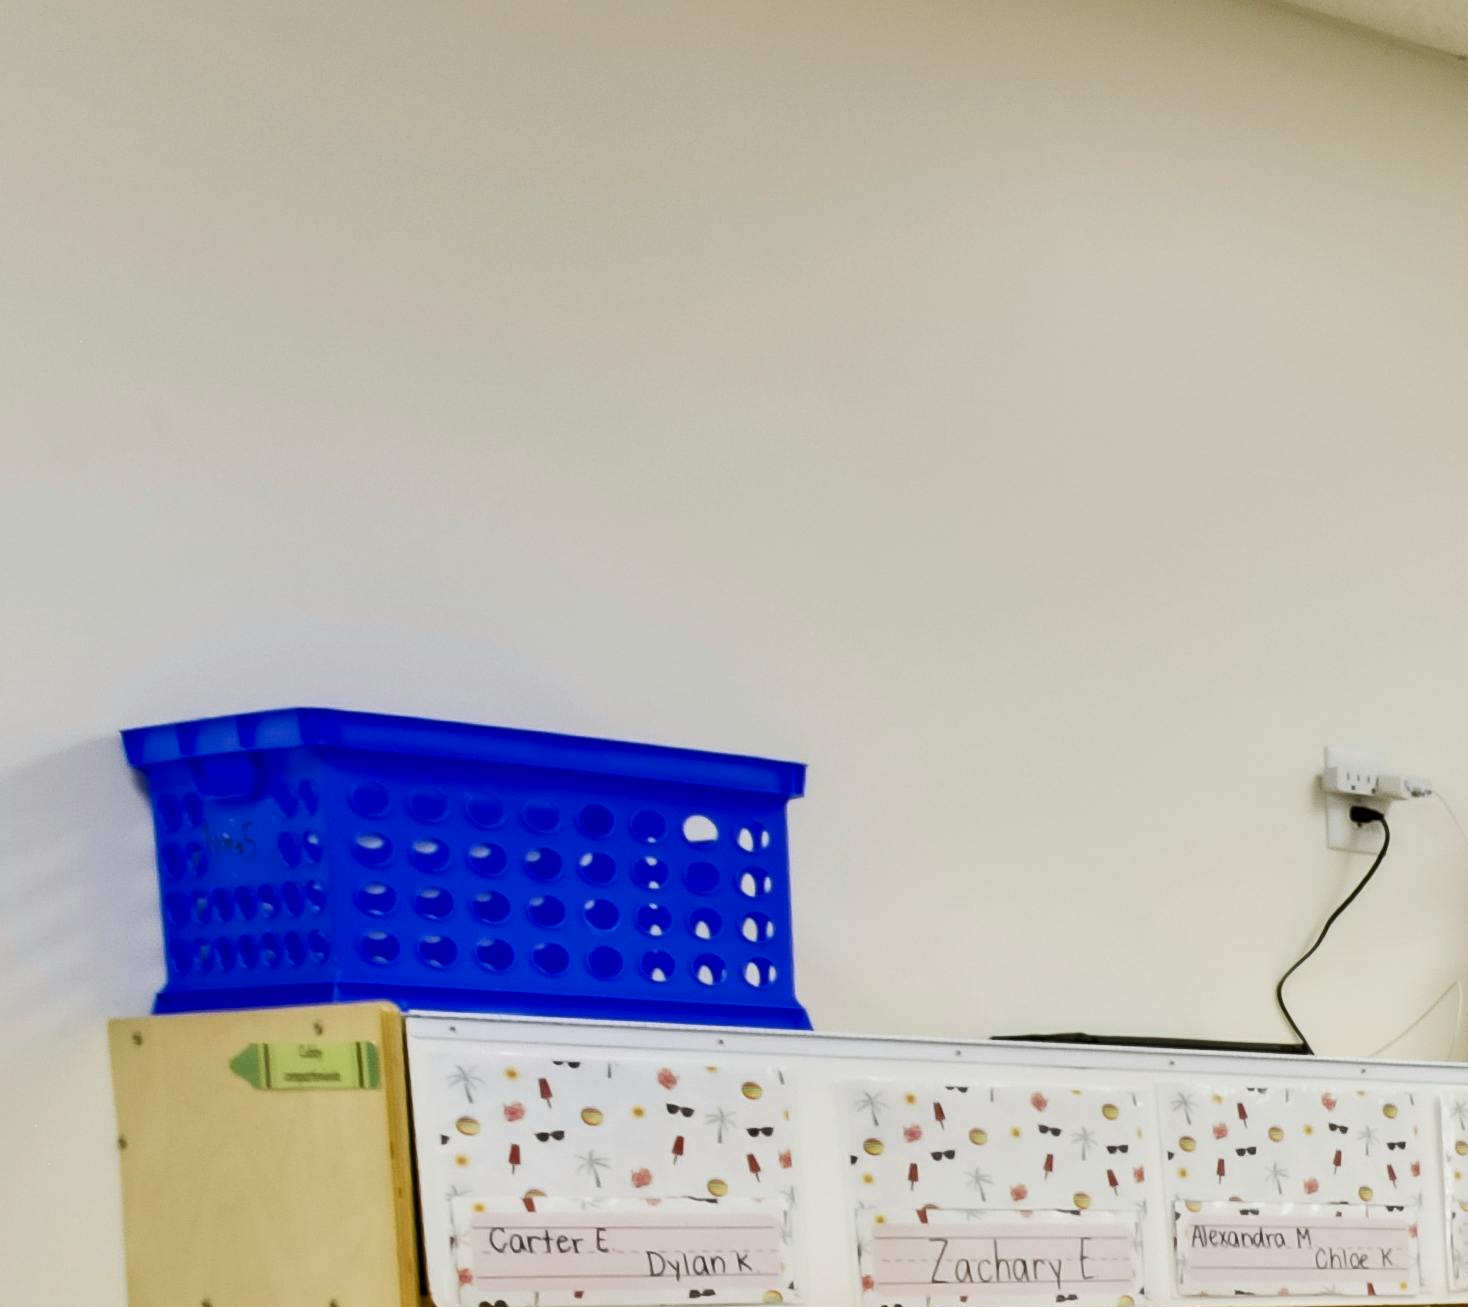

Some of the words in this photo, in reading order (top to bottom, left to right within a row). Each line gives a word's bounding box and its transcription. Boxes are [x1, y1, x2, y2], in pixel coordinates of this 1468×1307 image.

[488, 1226, 584, 1253] Carter
[595, 1227, 610, 1252] E
[1191, 1224, 1286, 1248] Alexandra
[1296, 1226, 1312, 1249] M
[646, 1250, 726, 1281] Dylan
[928, 1236, 1063, 1289] Zachary
[1080, 1236, 1097, 1280] E
[1314, 1248, 1370, 1270] Chloe
[1381, 1248, 1393, 1267] K
